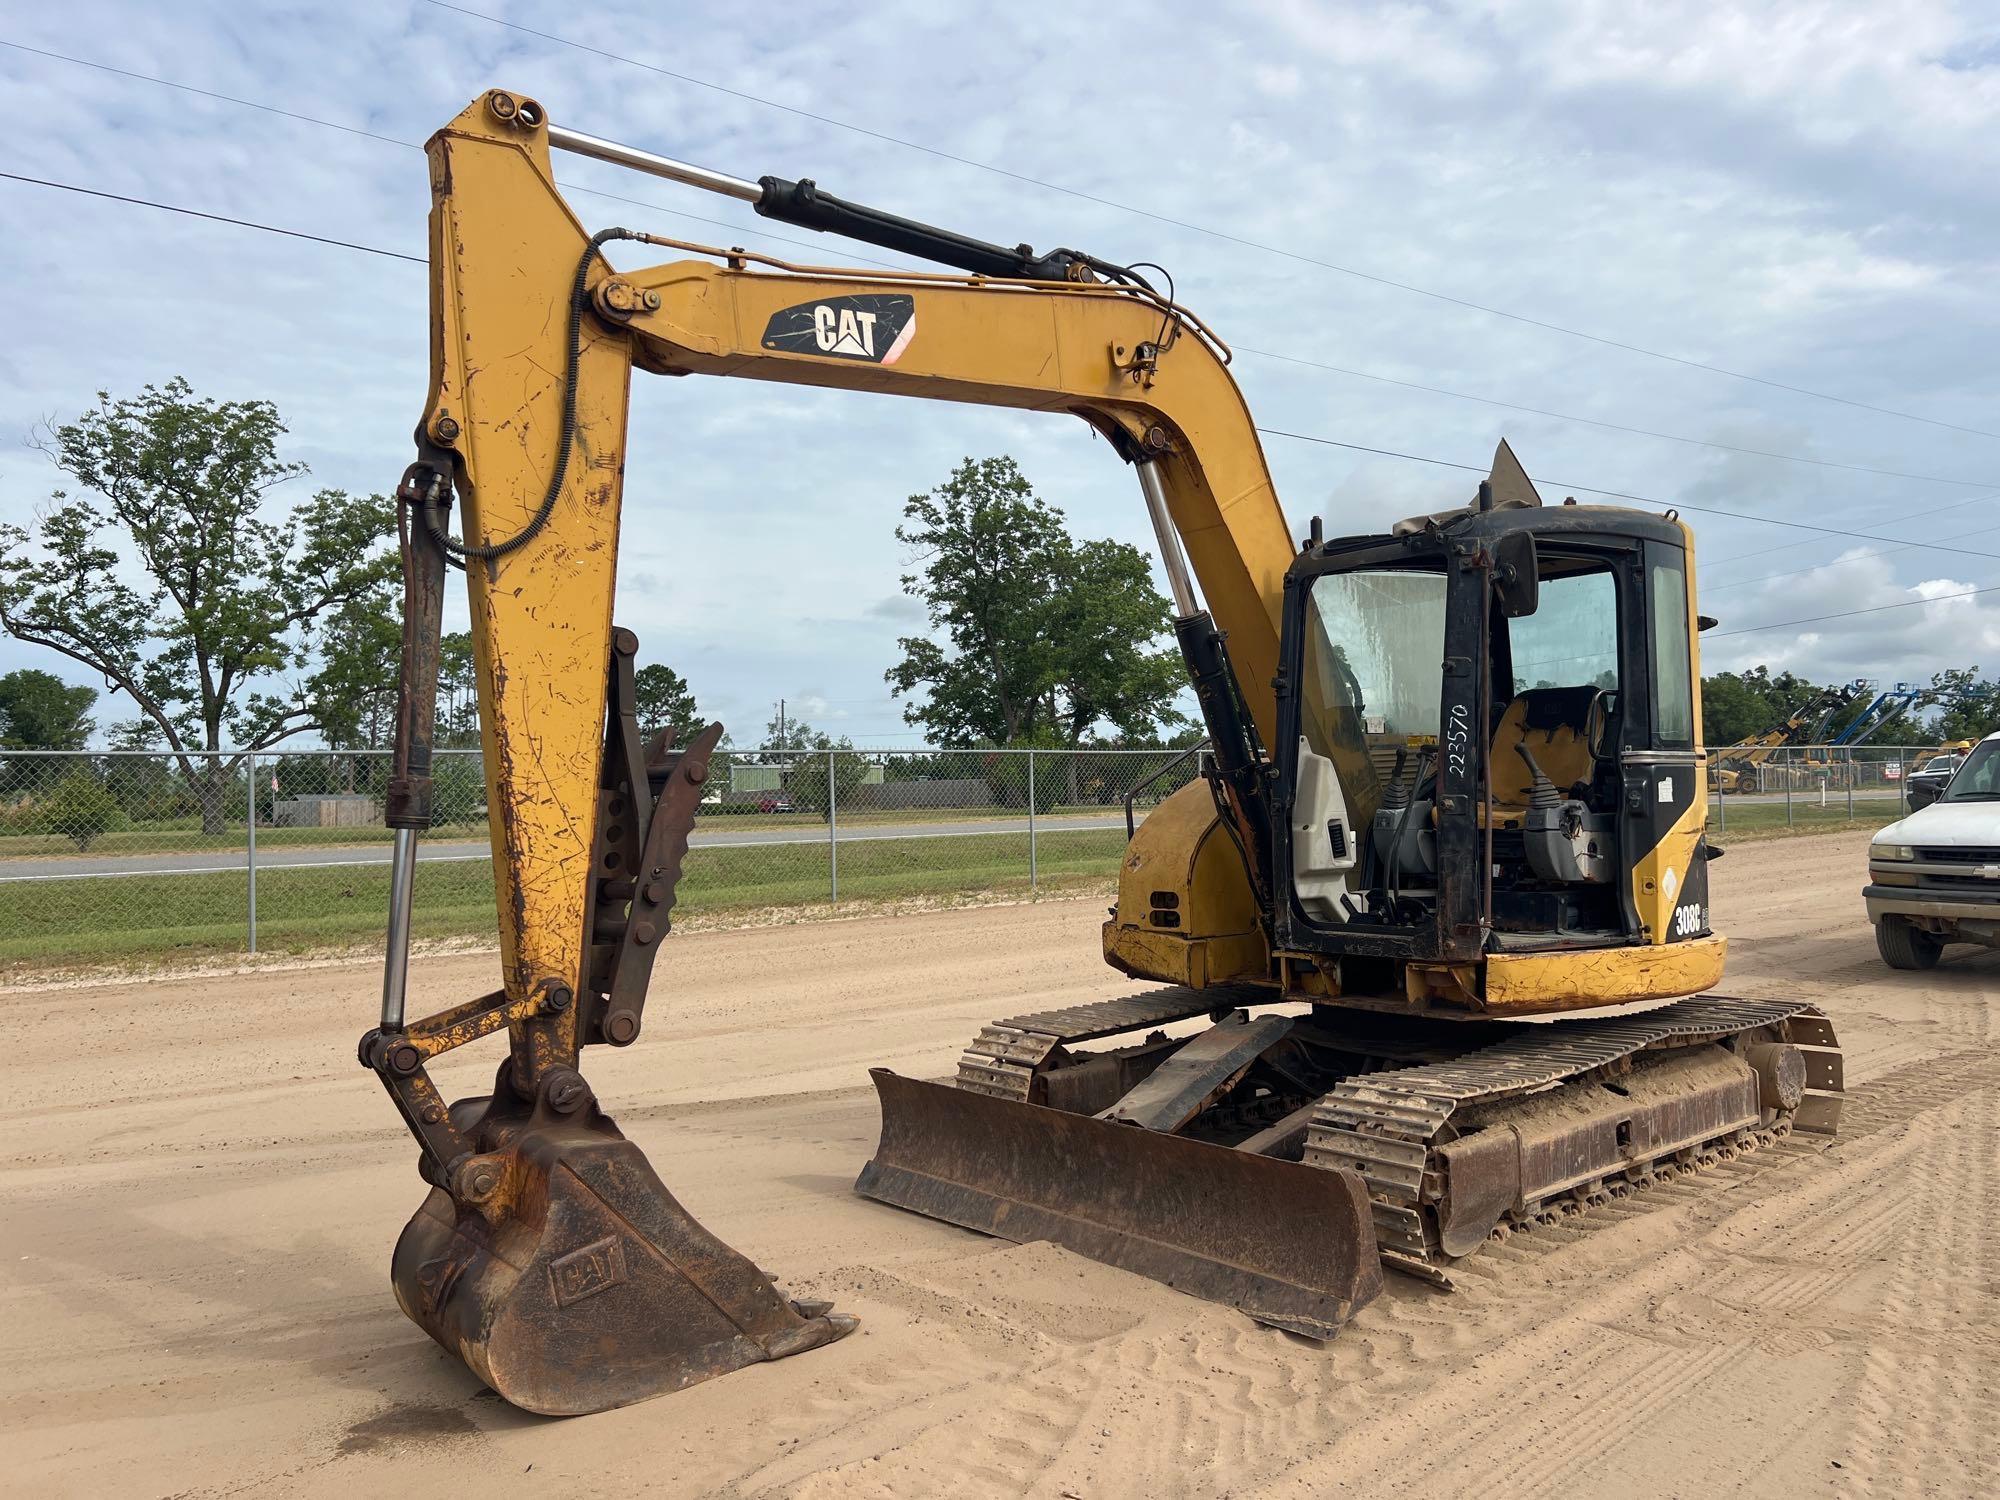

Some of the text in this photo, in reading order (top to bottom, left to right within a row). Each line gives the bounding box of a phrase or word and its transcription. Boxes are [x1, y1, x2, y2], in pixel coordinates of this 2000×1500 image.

[814, 304, 877, 357] CAT
[1447, 704, 1468, 778] 223570
[1675, 903, 1701, 936] 308C
[561, 1245, 616, 1297] CAT
